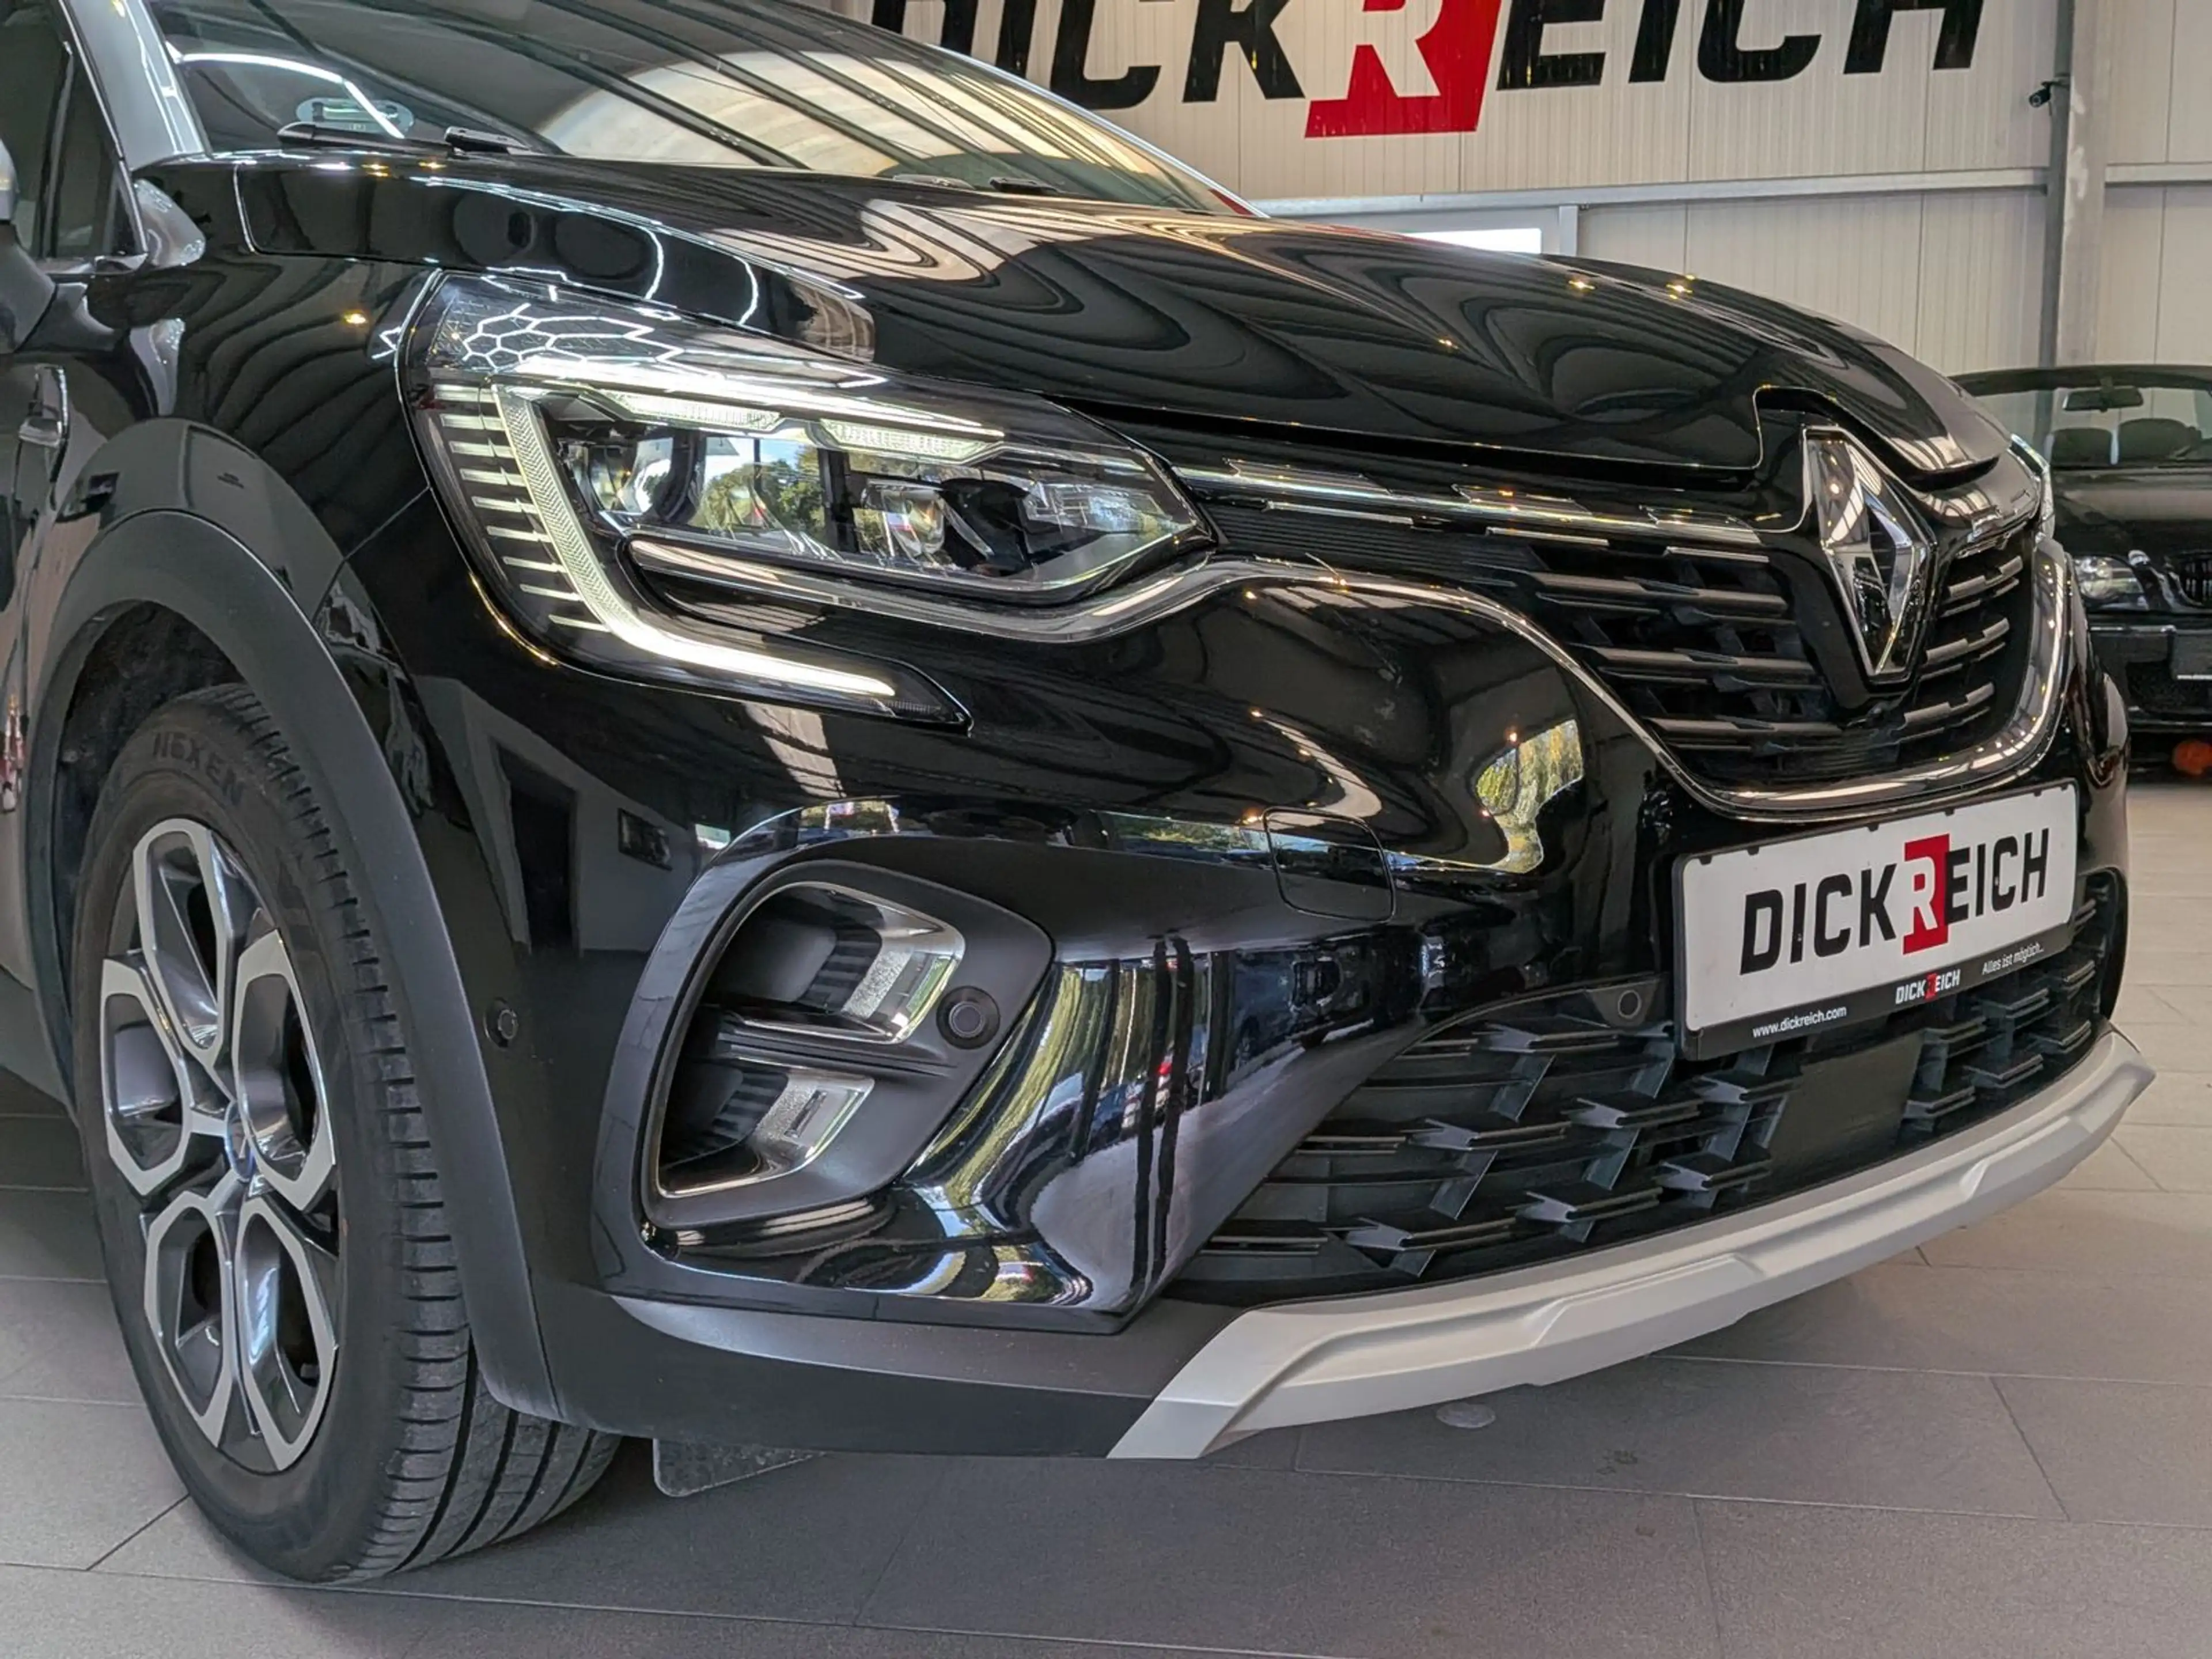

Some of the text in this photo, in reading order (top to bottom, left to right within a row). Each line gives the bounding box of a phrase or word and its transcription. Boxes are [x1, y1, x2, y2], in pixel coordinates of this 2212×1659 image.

[871, 0, 1984, 138] CKREIC
[1739, 828, 2049, 975] DICKREICH
[1982, 959, 2002, 975] Alles
[1752, 1006, 1847, 1037] www.dickreich.com
